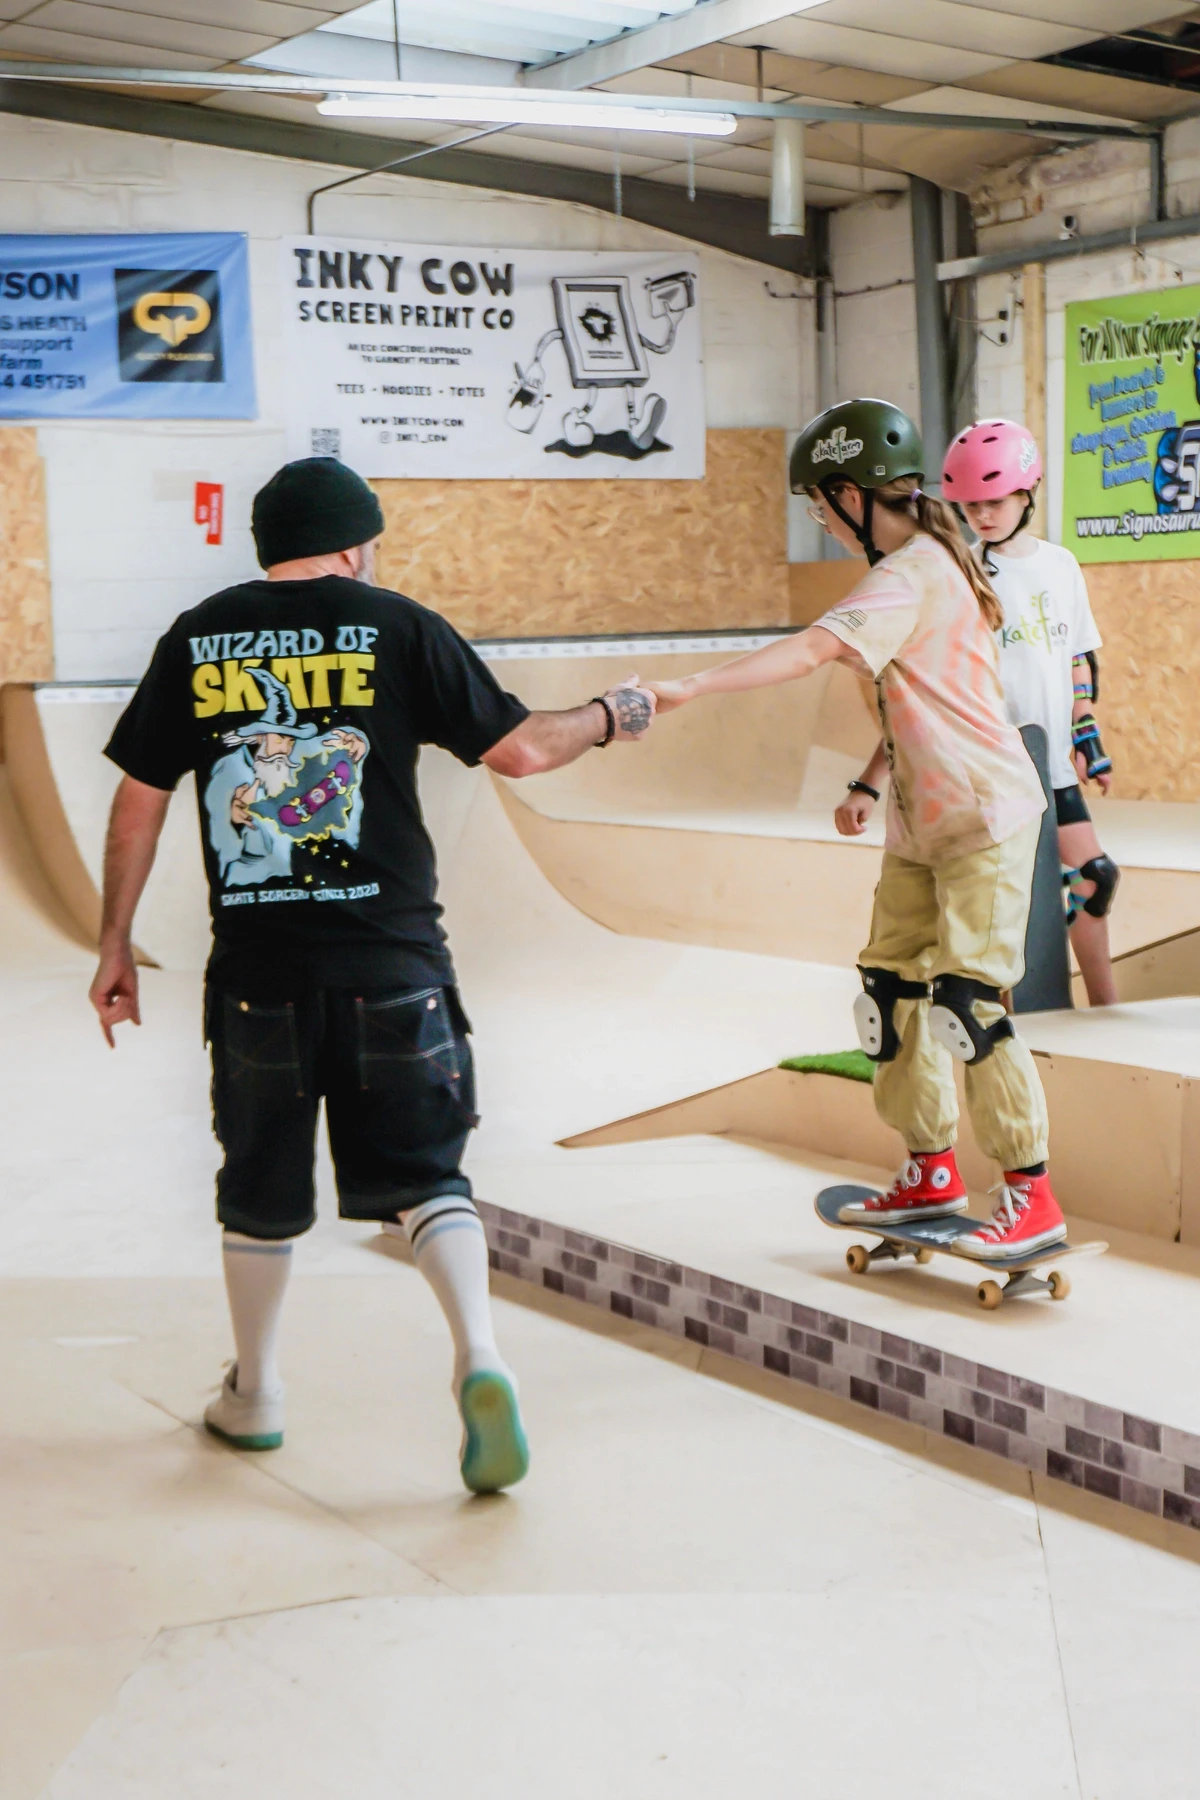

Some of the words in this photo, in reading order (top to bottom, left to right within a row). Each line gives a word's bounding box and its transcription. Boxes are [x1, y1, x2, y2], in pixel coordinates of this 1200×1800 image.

[0, 271, 79, 301] SON
[294, 248, 403, 293] INKY
[421, 258, 514, 297] COW
[17, 315, 87, 332] HEATH
[300, 300, 394, 325] SCREEN
[401, 304, 475, 329] PRINT
[483, 307, 515, 330] CO
[1099, 318, 1116, 361] All
[1113, 321, 1141, 359] Your
[1141, 312, 1195, 365] Signage
[337, 383, 365, 395] TEES
[382, 384, 432, 397] HOODIES
[450, 386, 486, 398] TOTES
[189, 628, 325, 665] WIZARD
[335, 626, 379, 653] OF
[192, 653, 375, 719] SKATE
[221, 892, 256, 907] SKATE
[312, 888, 347, 902] SINCE
[347, 882, 381, 900] 2020
